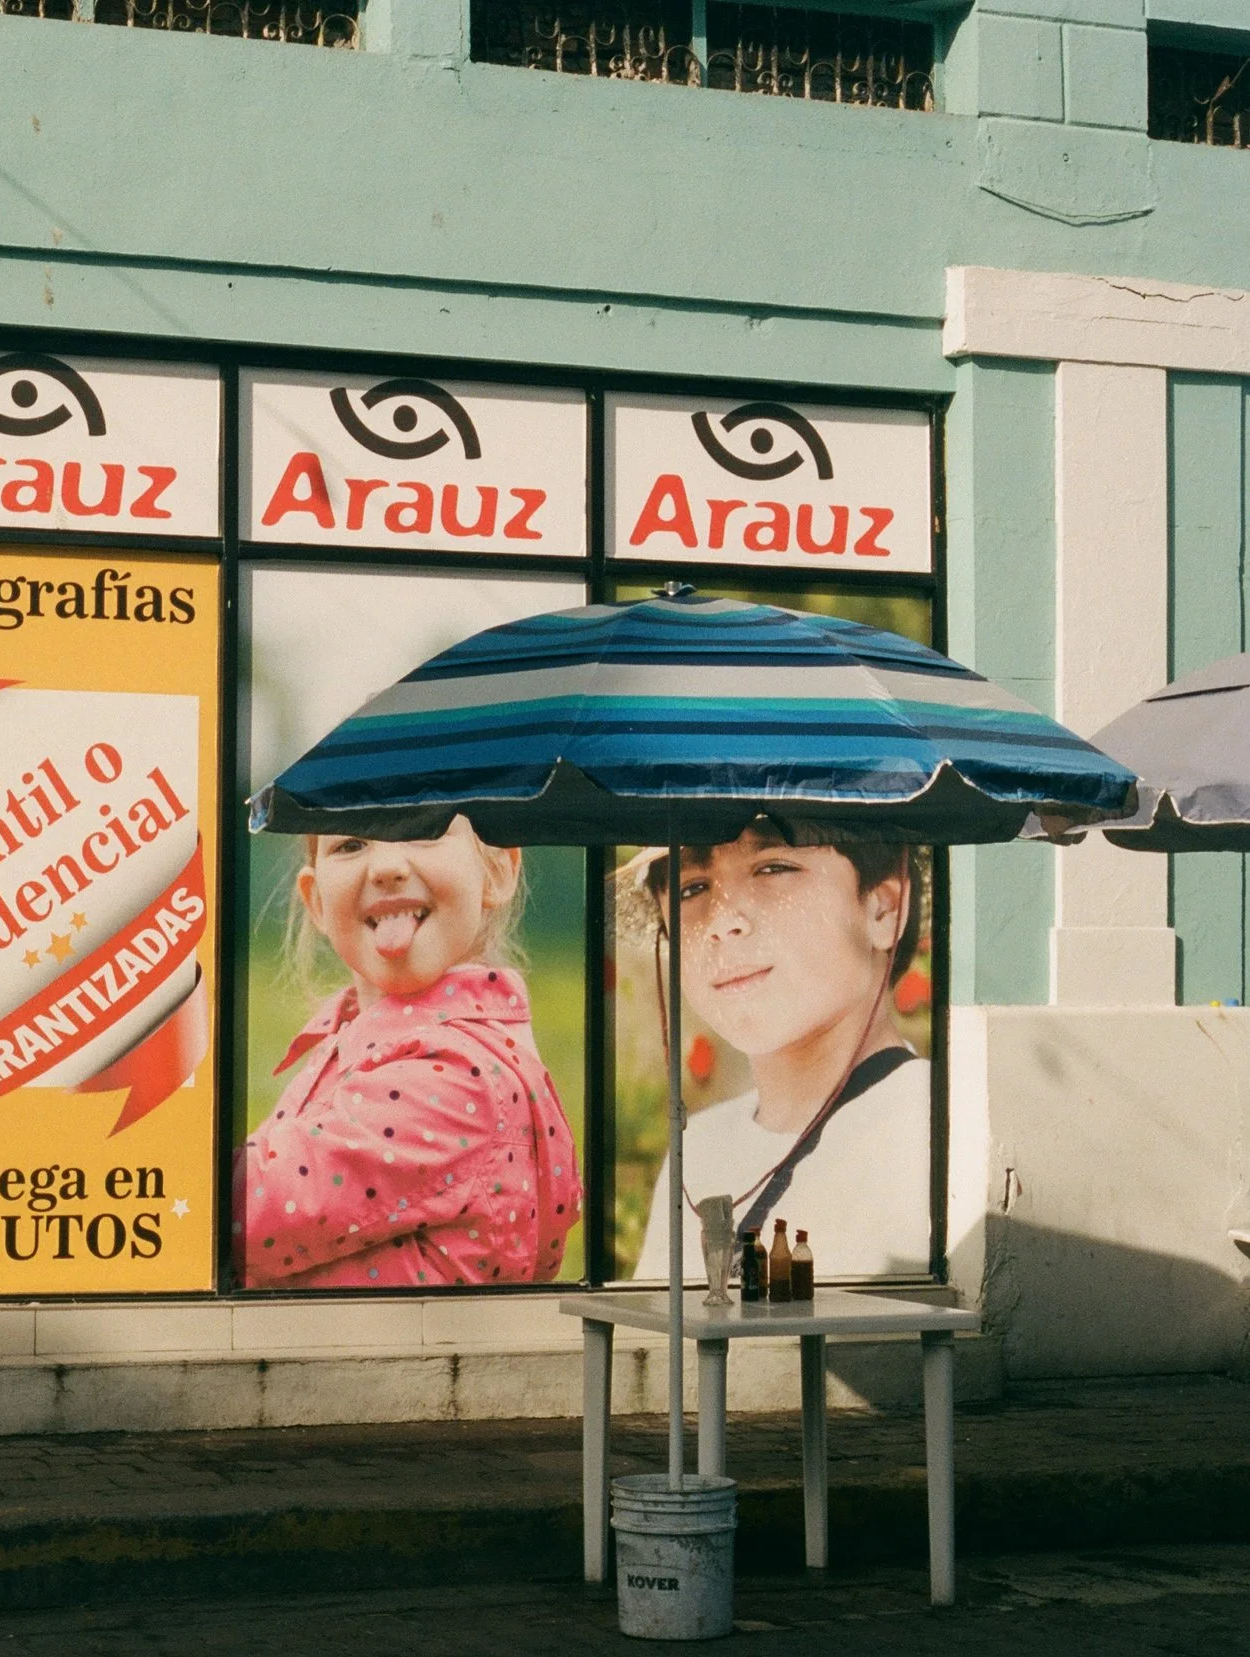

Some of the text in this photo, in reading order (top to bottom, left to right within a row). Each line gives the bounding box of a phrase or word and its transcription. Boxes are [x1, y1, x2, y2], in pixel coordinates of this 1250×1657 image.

[260, 451, 547, 540] Arauz
[629, 473, 894, 557] Arauz
[84, 742, 123, 784] o
[105, 1165, 166, 1200] en
[627, 1574, 680, 1591] KOVER
